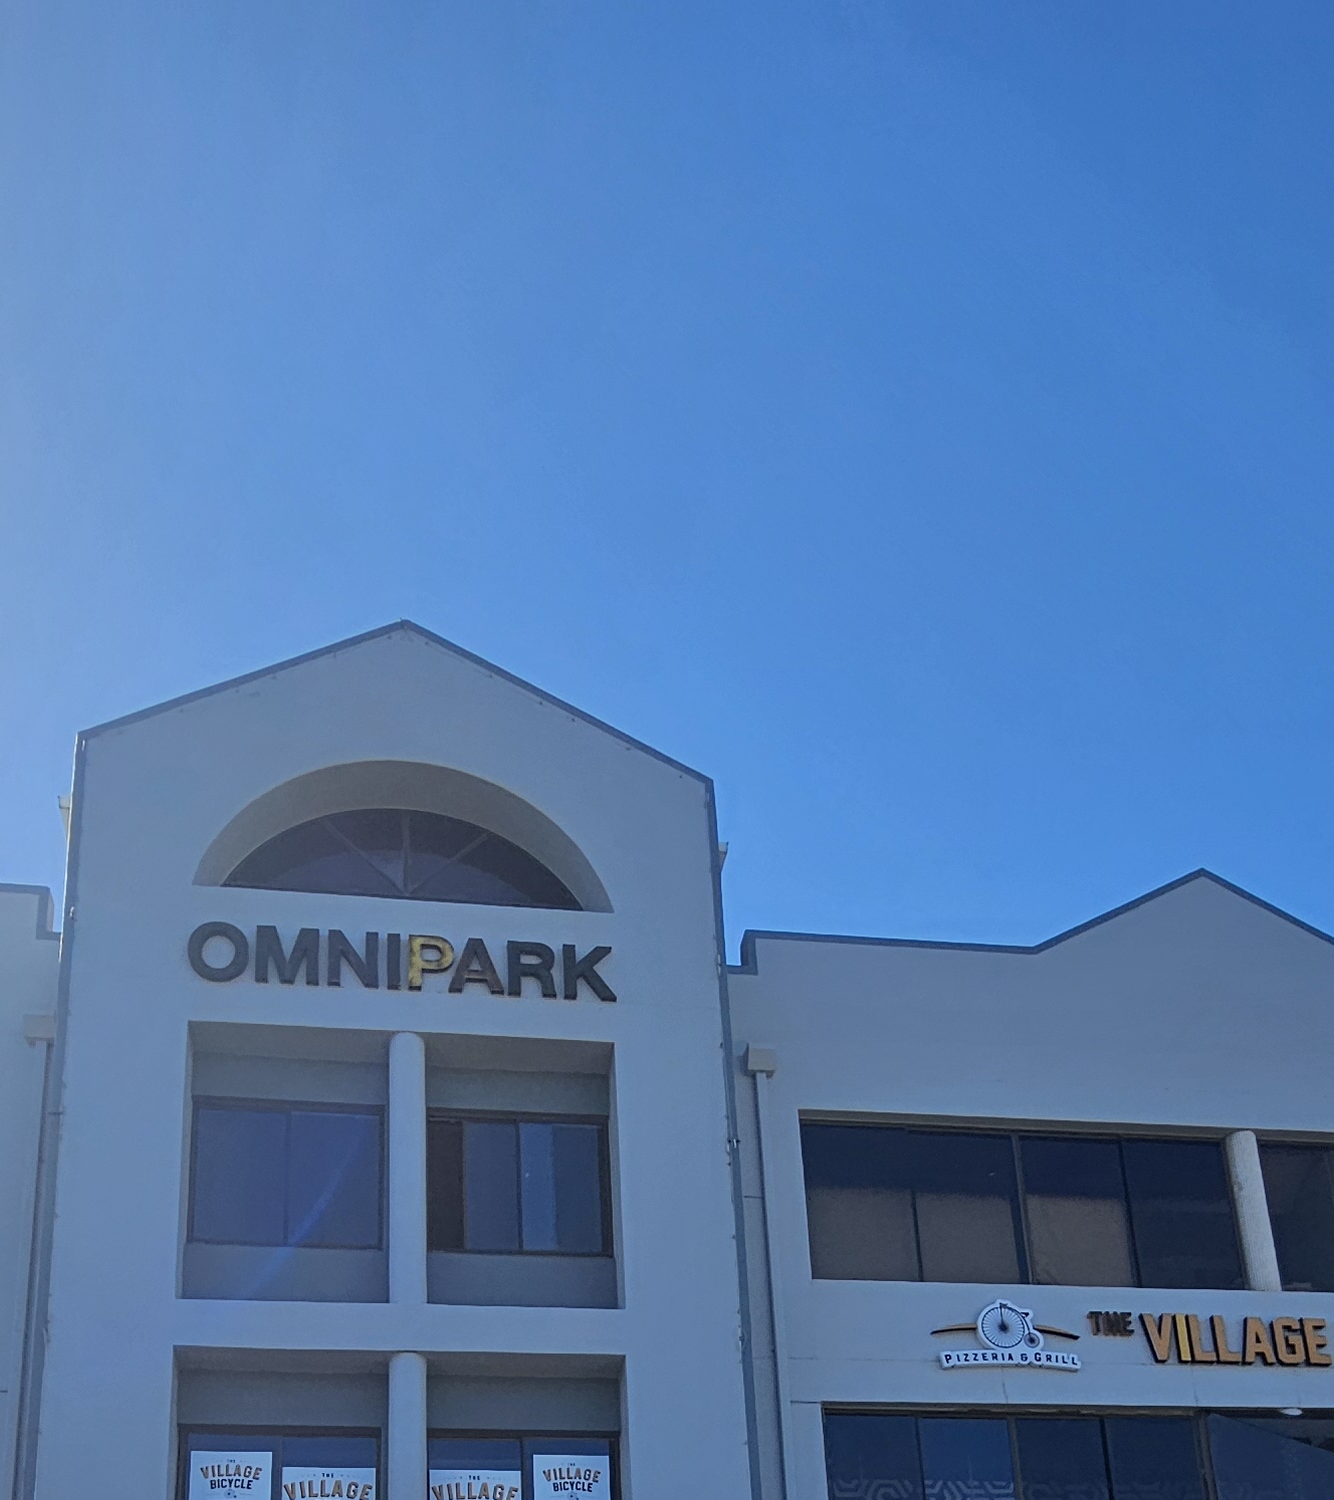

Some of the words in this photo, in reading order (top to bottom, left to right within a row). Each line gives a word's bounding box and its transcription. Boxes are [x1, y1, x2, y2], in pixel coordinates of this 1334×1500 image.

[188, 920, 617, 1002] OMNIPARK
[1087, 1311, 1134, 1336] THE
[1139, 1313, 1333, 1366] VILLAGE
[945, 1352, 1014, 1364] PIZZERIA
[1034, 1352, 1078, 1366] GRILL
[200, 1463, 263, 1480] VILLAGE
[542, 1467, 601, 1483] VILLAGE
[210, 1478, 253, 1490] BICYCLE
[552, 1481, 593, 1493] BICYCLE
